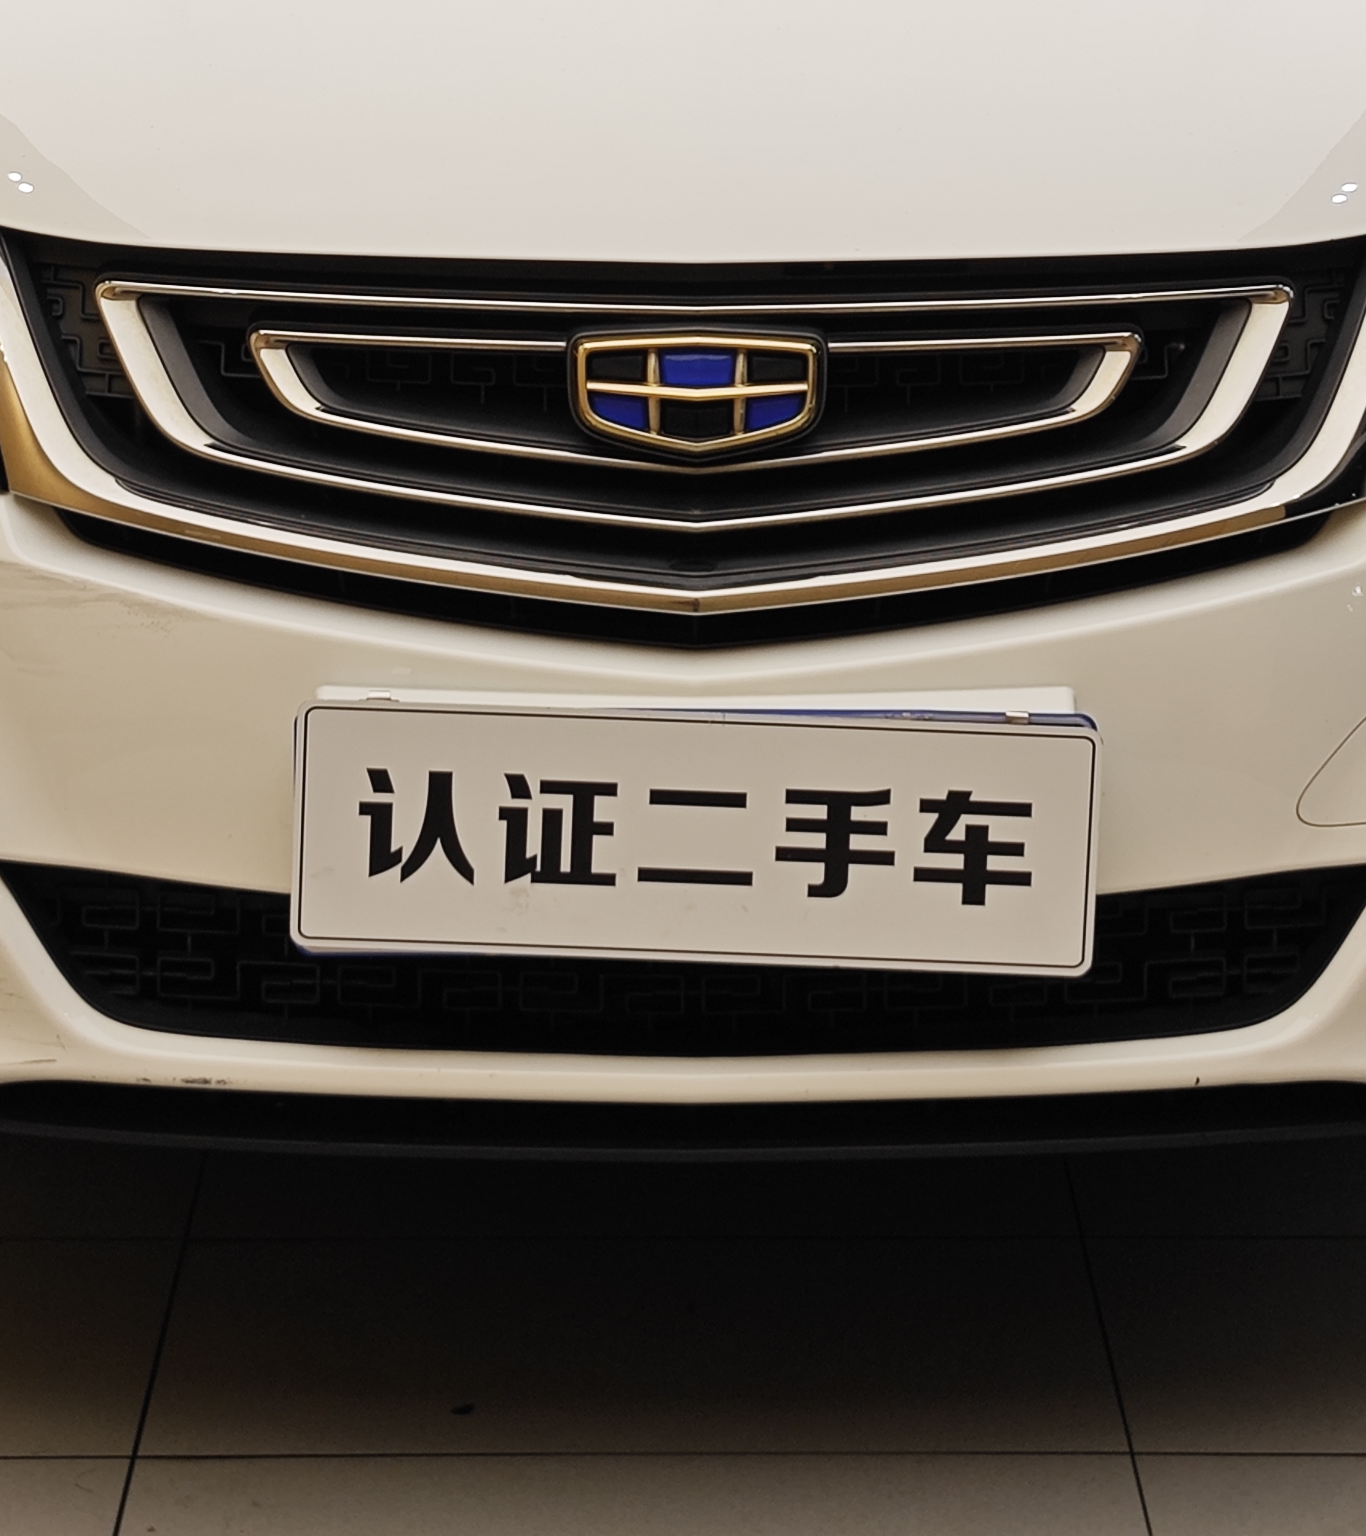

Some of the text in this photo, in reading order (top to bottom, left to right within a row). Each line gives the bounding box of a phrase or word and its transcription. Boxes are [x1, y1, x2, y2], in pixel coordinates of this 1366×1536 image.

[358, 767, 1033, 906] 认证二手车
